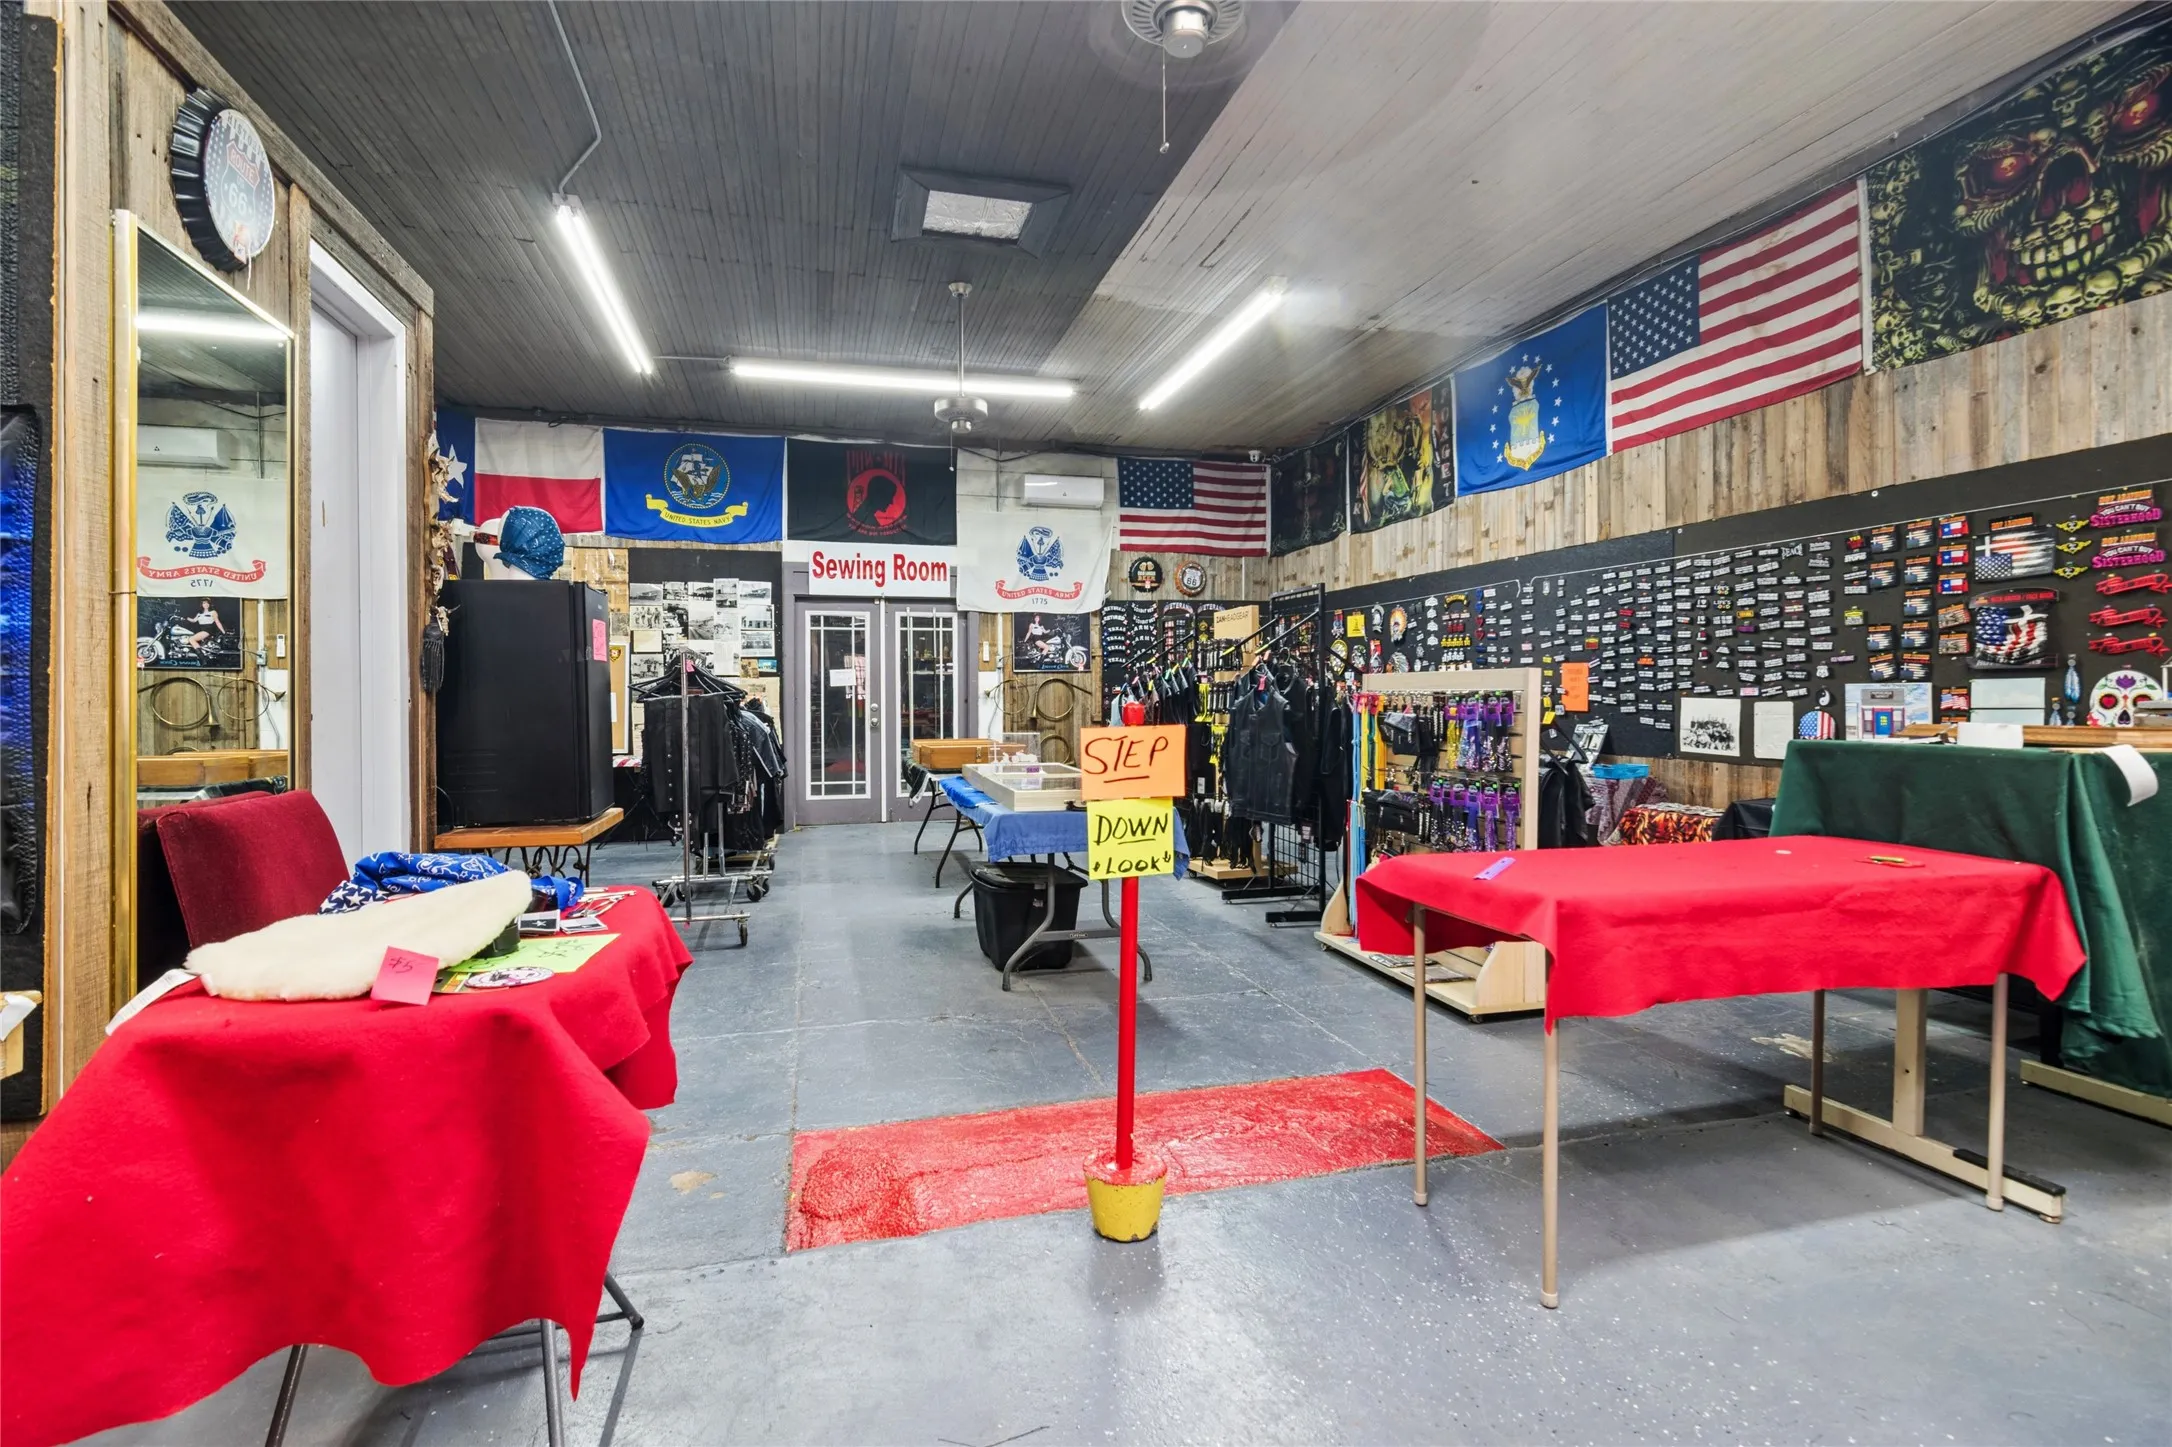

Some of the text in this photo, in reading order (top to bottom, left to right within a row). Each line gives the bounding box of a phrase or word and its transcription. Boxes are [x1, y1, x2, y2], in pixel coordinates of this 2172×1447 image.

[230, 148, 256, 183] ROUTE
[228, 183, 247, 214] 66
[664, 512, 731, 525] UNITED STATES NAVY
[2090, 508, 2162, 527] SISTERHOOD
[2092, 550, 2165, 569] SISTERHOOD
[812, 551, 947, 588] Sewing Room
[1002, 590, 1026, 598] UNITED
[1027, 587, 1053, 595] STATES
[1031, 597, 1048, 605] 1775
[1084, 735, 1169, 775] STEP
[1093, 813, 1168, 846] DOWN
[1106, 856, 1160, 874] LOOK
